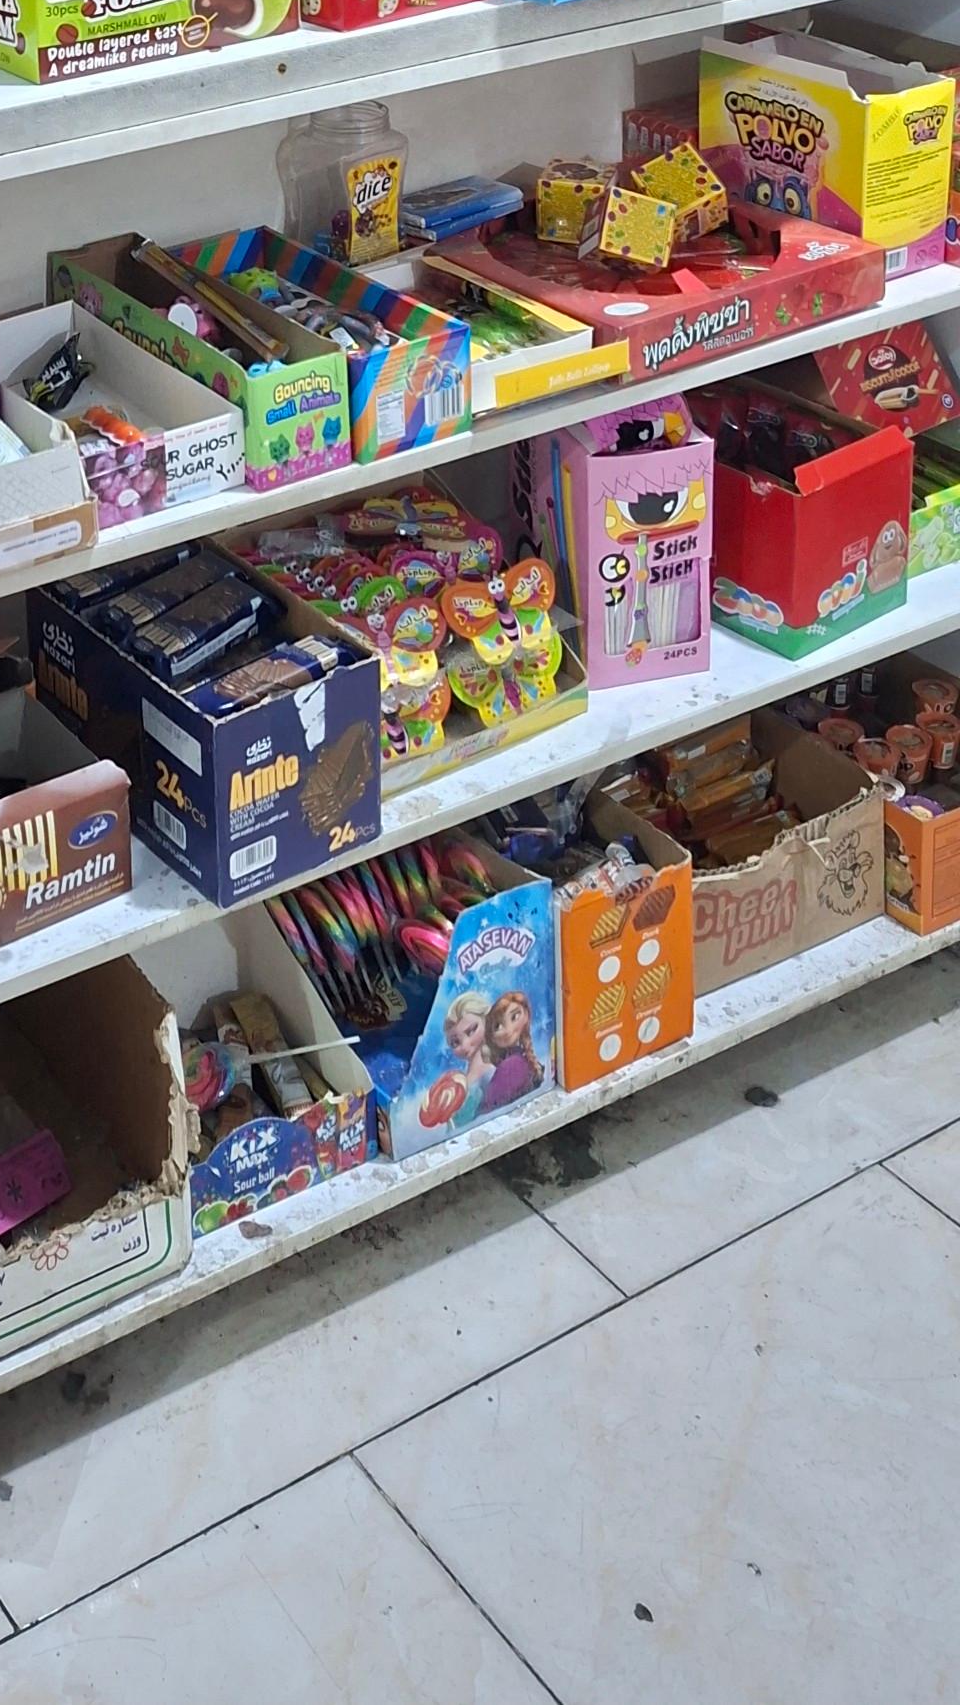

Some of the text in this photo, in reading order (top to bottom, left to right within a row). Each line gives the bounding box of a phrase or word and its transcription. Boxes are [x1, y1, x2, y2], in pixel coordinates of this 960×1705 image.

[45, 2, 79, 19] 30pcs
[87, 12, 167, 37] MARSHMALLOW
[48, 35, 144, 63] Double layered
[48, 40, 178, 78] A dreamlike feeling
[725, 91, 799, 121] CARAMELO
[800, 111, 823, 136] EN
[908, 114, 946, 137] POLVO
[735, 113, 815, 155] POLVO
[751, 139, 806, 172] SABOR
[356, 174, 391, 206] dice
[275, 371, 330, 404] Bouncing
[267, 400, 296, 425] Small
[188, 432, 238, 457] GHOST
[165, 457, 215, 482] SUGAR
[653, 535, 698, 561] Stick
[649, 559, 693, 584] Stick
[42, 622, 74, 657] نظری
[663, 646, 698, 661] 24PCS
[246, 736, 272, 757] نظری
[246, 750, 272, 766] nazari
[230, 754, 300, 811] Arinte
[250, 803, 275, 820] COCOA
[255, 792, 280, 807] WAFER
[24, 851, 117, 909] Ramtin
[458, 947, 483, 973] ATA
[484, 926, 535, 958] SEVAN
[233, 1167, 276, 1194] Sour ball
[122, 1235, 142, 1253] وزن
